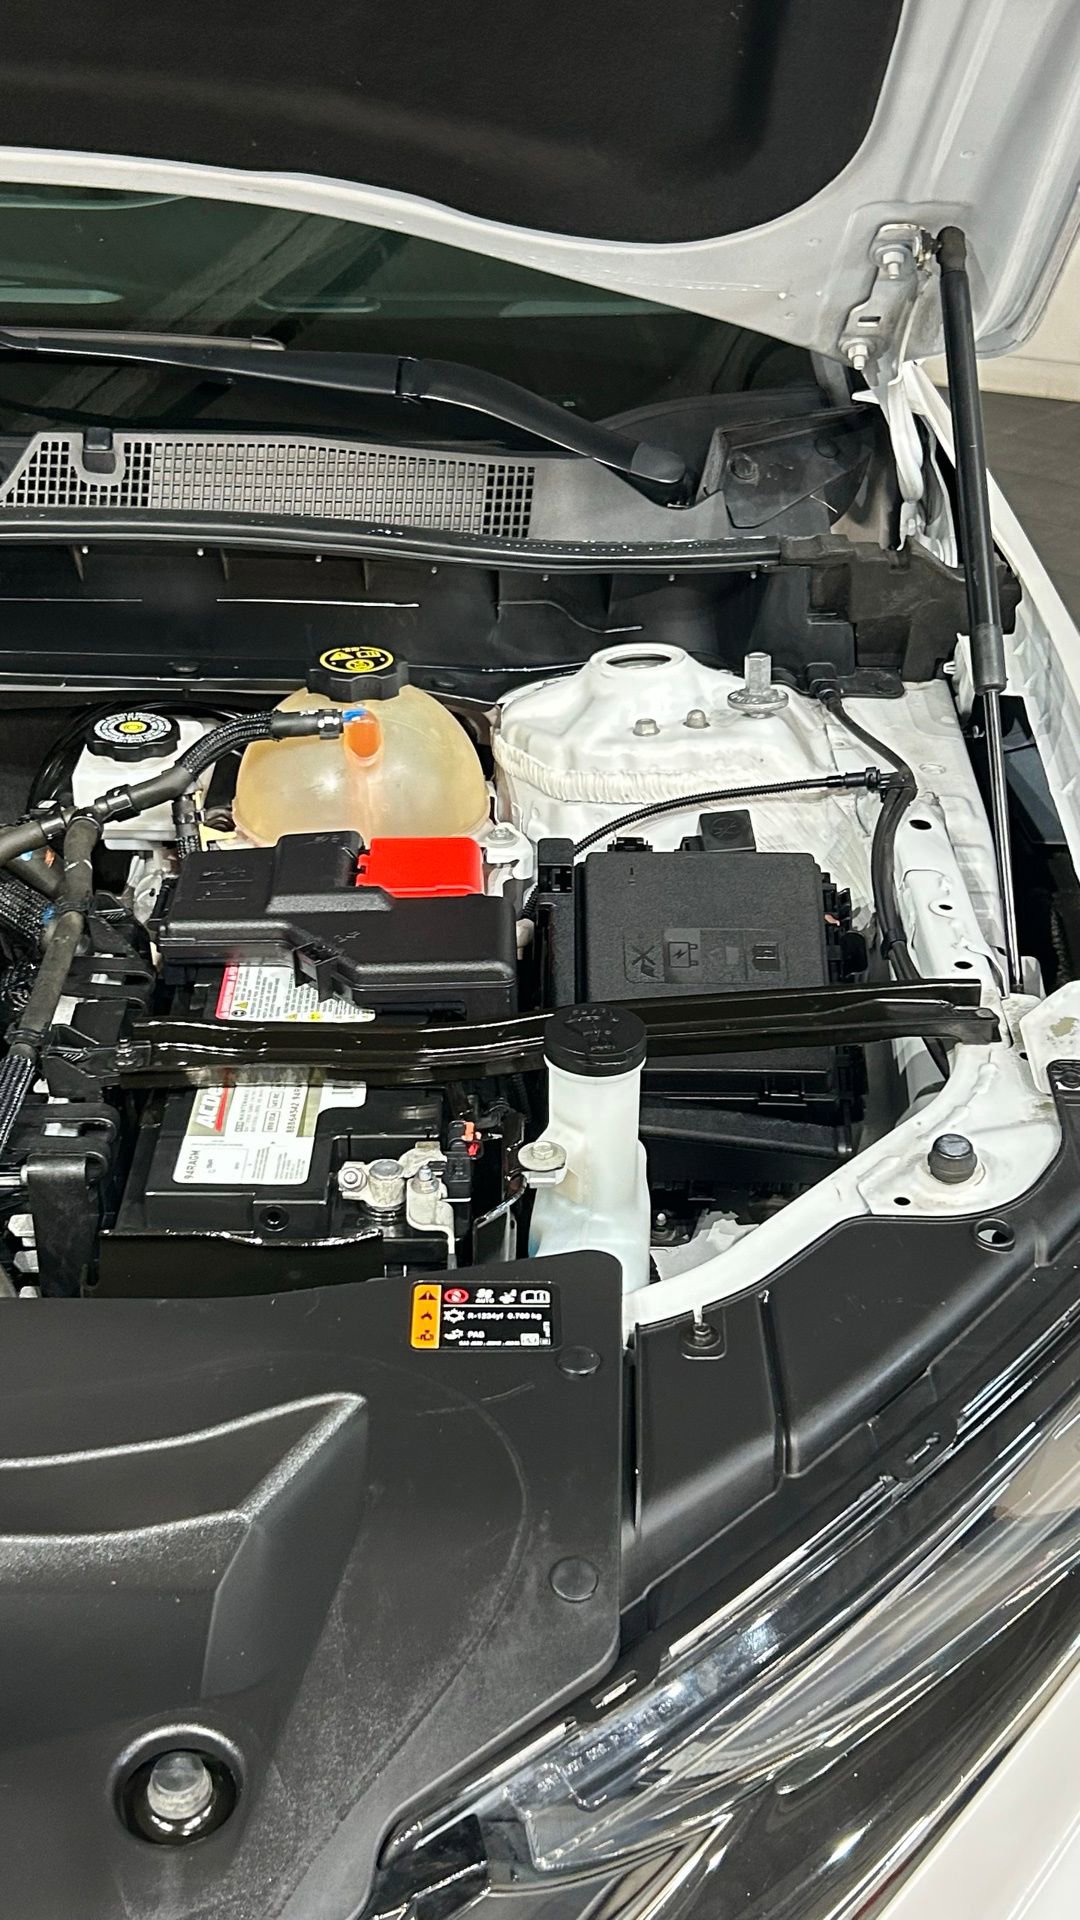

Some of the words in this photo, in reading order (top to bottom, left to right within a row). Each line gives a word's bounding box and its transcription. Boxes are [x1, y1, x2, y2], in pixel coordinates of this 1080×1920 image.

[183, 1150, 200, 1179] 94RAGM
[467, 1312, 504, 1320] R-1234yf
[531, 1312, 542, 1320] kg
